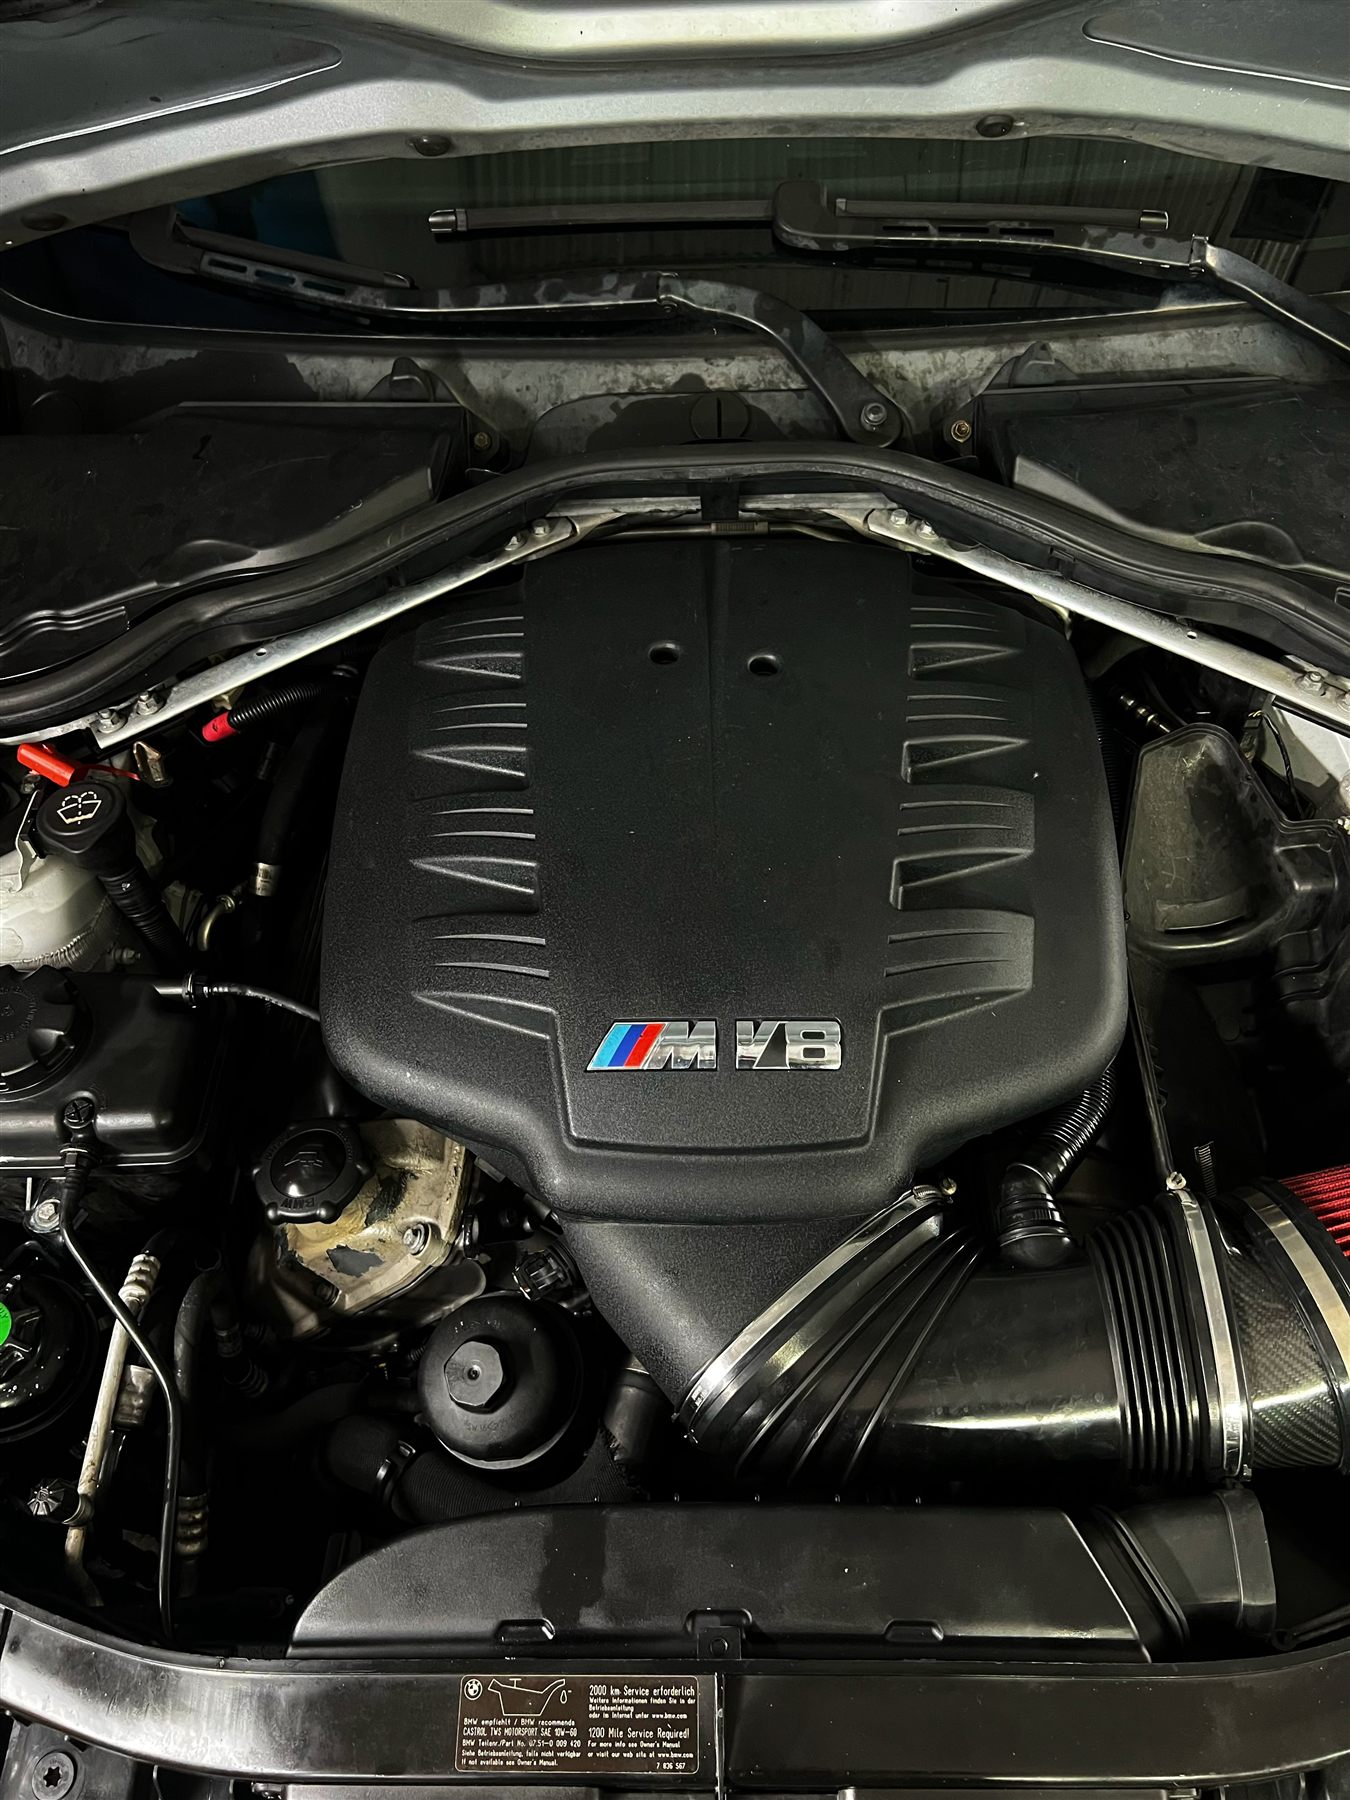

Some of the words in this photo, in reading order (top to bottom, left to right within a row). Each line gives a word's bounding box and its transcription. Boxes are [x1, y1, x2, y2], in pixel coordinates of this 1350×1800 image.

[735, 1020, 842, 1071] V8
[589, 1685, 607, 1696] 2000
[653, 1686, 695, 1696] erforderlich
[463, 1718, 478, 1726] BMW
[481, 1718, 511, 1726] empfiehlt
[463, 1728, 487, 1736] CASTROL
[490, 1728, 502, 1736] TWS
[504, 1727, 538, 1736] MOTORSPORT
[541, 1728, 551, 1736] SAE
[554, 1728, 578, 1737] 10W-60
[588, 1727, 605, 1738] 1200
[608, 1728, 623, 1738] Mile
[627, 1728, 653, 1738] Service
[656, 1762, 661, 1770] 7
